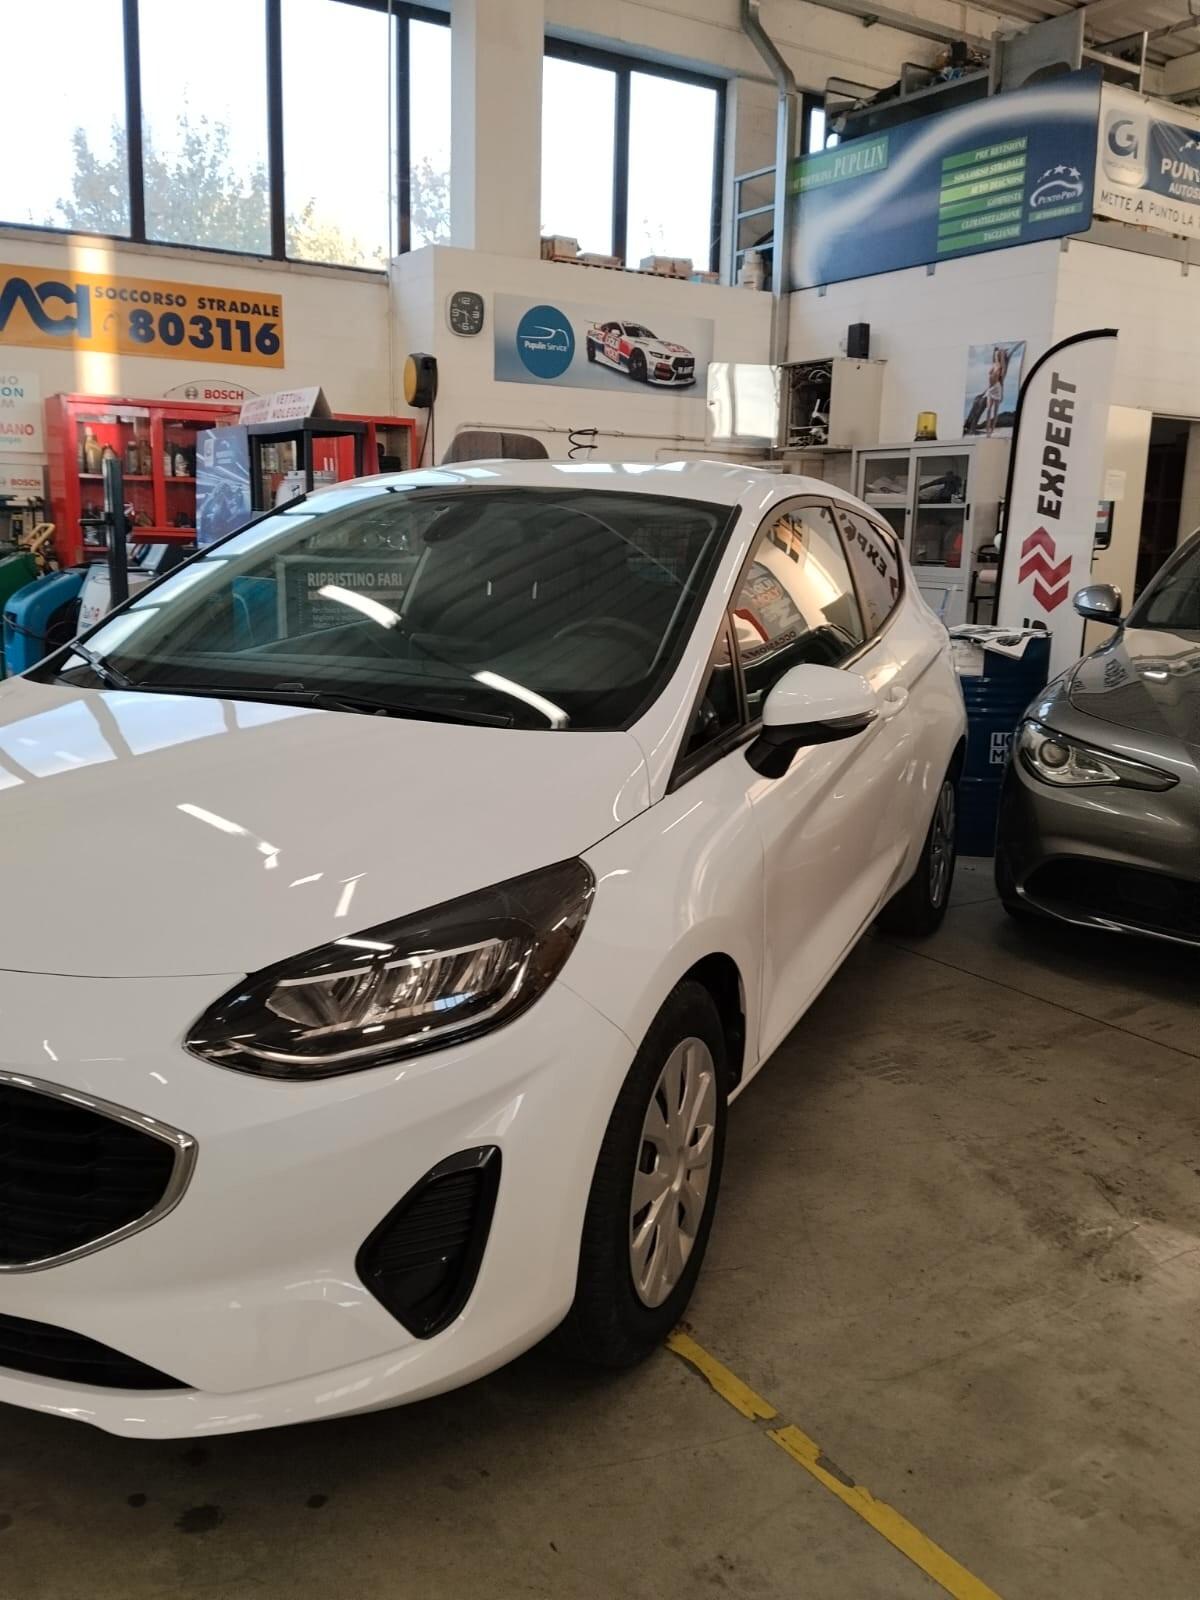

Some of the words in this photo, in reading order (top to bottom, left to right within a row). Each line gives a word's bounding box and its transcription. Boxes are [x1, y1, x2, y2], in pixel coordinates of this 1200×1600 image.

[1100, 189, 1132, 211] METTE
[1135, 200, 1144, 213] A
[1149, 202, 1178, 222] PUNTO
[1182, 212, 1193, 225] LA
[0, 277, 91, 338] ACI
[95, 286, 187, 307] SOCCORSO
[197, 297, 280, 317] STRADALE
[129, 308, 280, 355] 803116
[204, 389, 244, 400] BOSCH
[1037, 372, 1076, 519] EXPERT
[10, 478, 40, 487] BOSCH
[307, 572, 375, 587] RIPRISTINO
[377, 573, 402, 586] FARI
